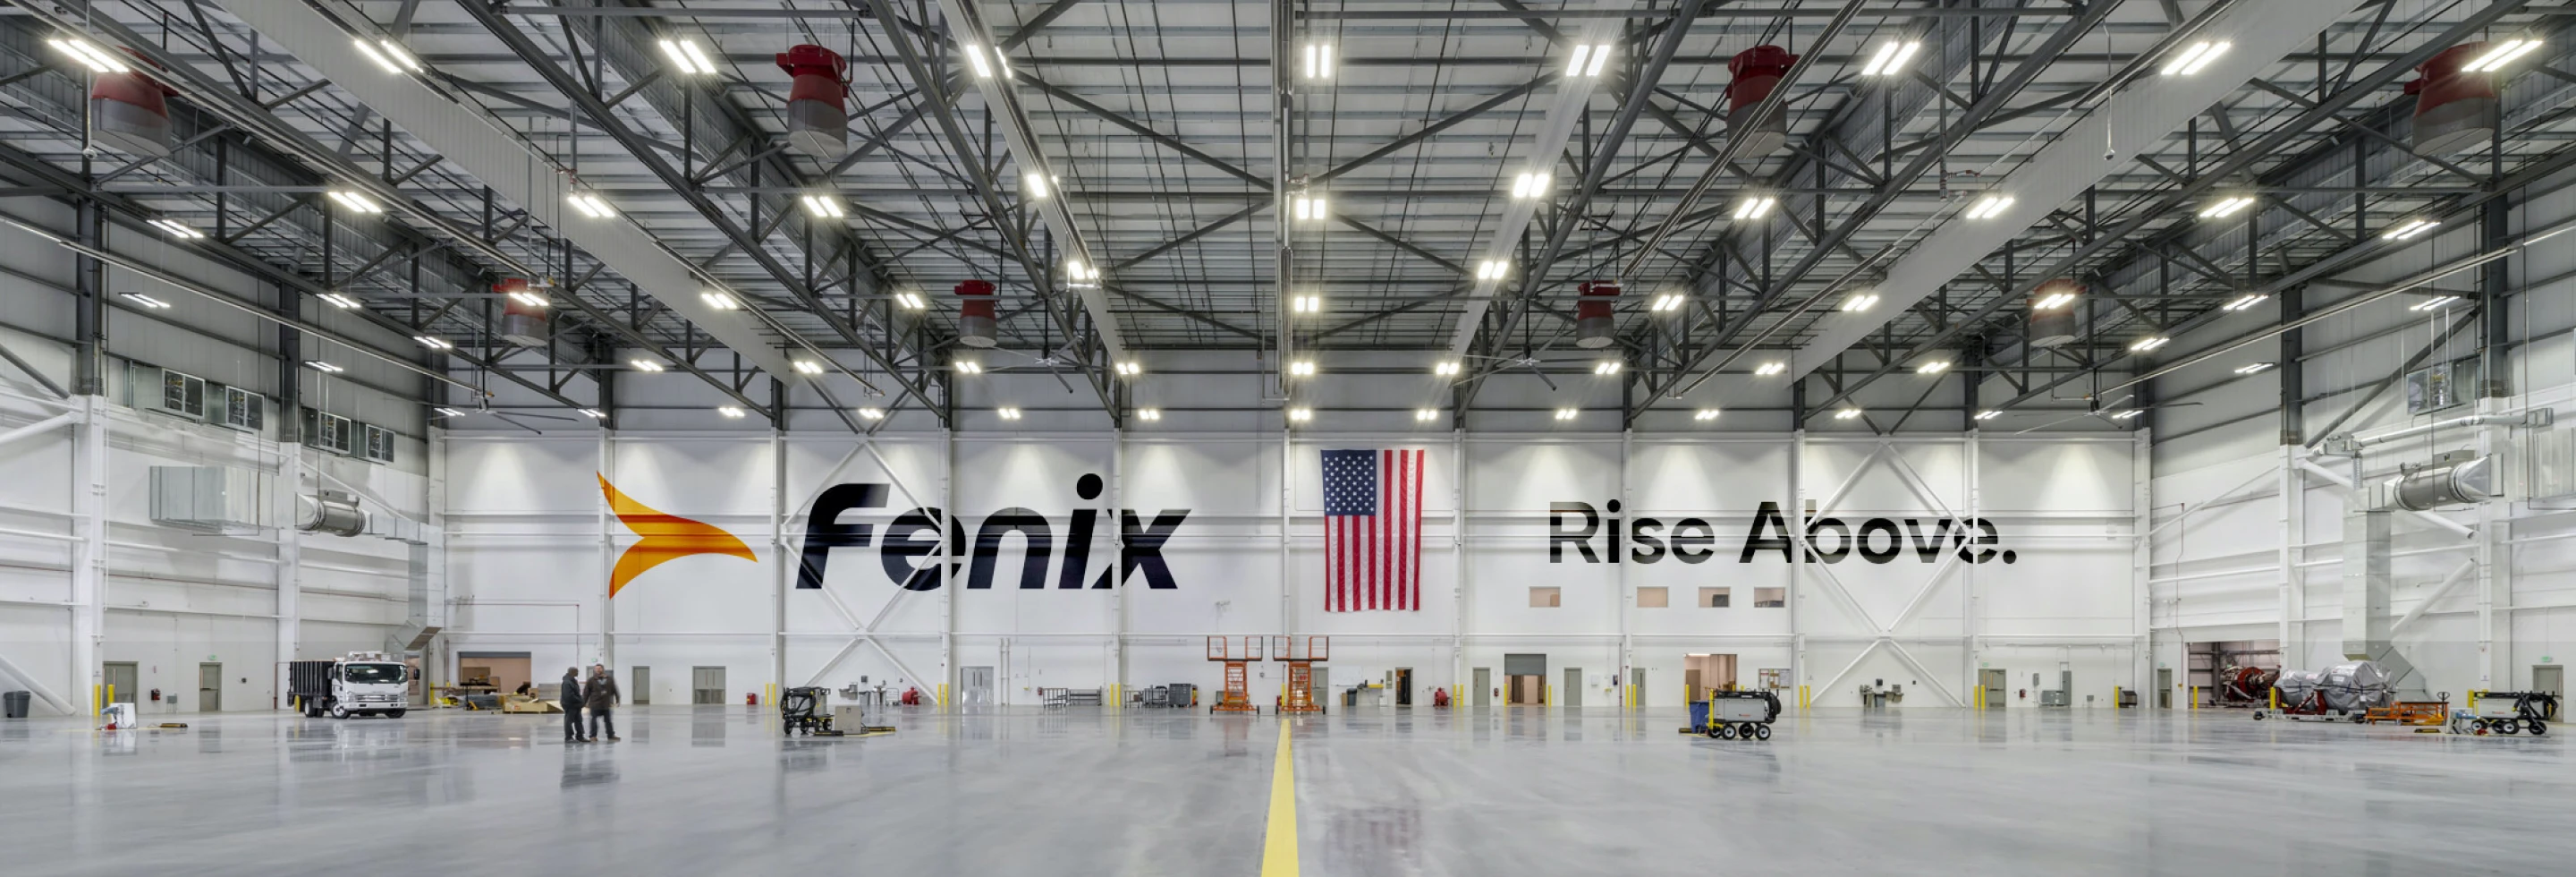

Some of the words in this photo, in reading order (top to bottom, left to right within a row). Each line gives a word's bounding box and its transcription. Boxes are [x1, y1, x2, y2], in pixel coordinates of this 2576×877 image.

[796, 473, 1191, 591] Fenix
[1550, 498, 1716, 565] Rise
[1739, 498, 2017, 565] Above.
